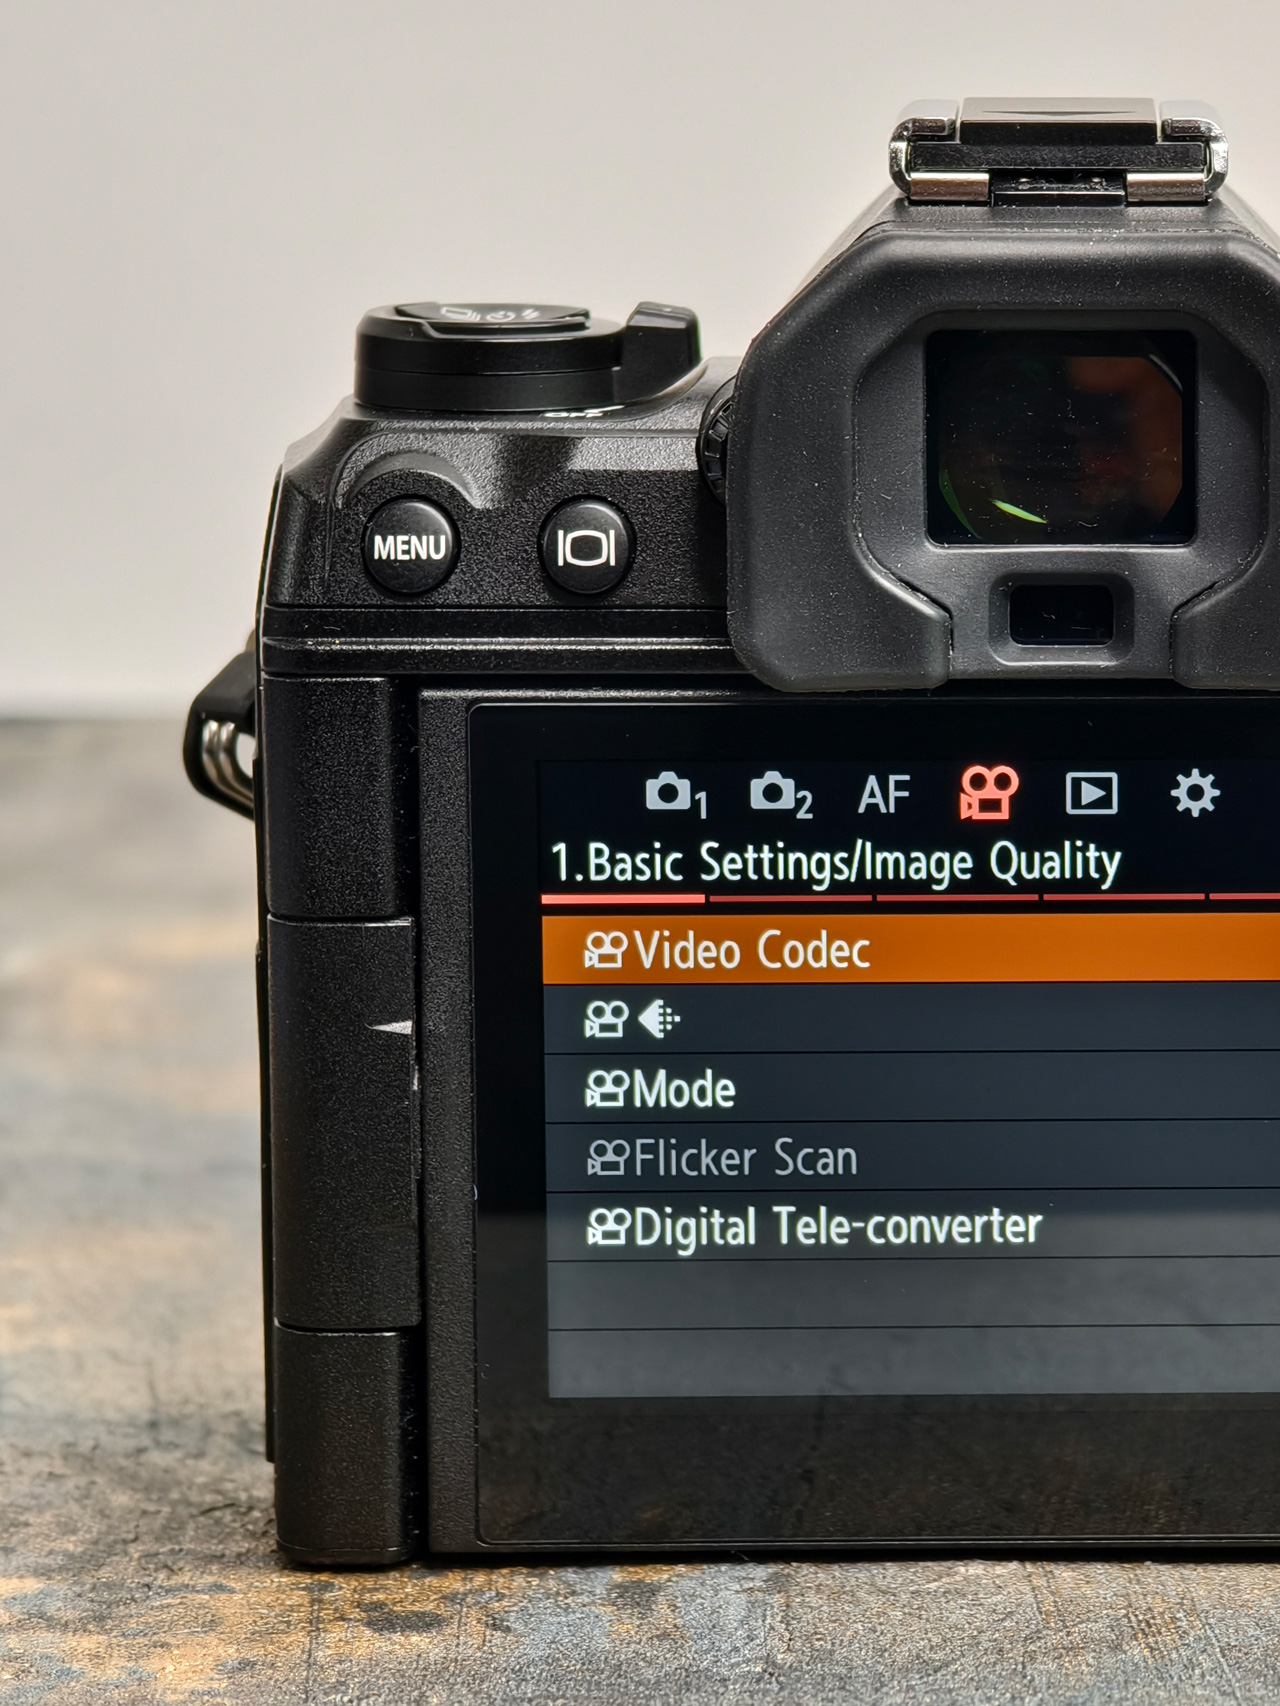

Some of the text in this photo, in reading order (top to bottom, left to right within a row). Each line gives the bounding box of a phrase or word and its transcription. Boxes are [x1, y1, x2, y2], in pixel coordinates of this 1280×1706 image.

[373, 534, 447, 561] MENU
[857, 774, 911, 814] AF
[552, 839, 1122, 891] 1.Basic Settings/Image Quality
[634, 929, 871, 969] Video Codec
[633, 1068, 737, 1108] Mode
[635, 1137, 858, 1176] Flicker Scan
[635, 1205, 1044, 1257] Digital Tele-converter
